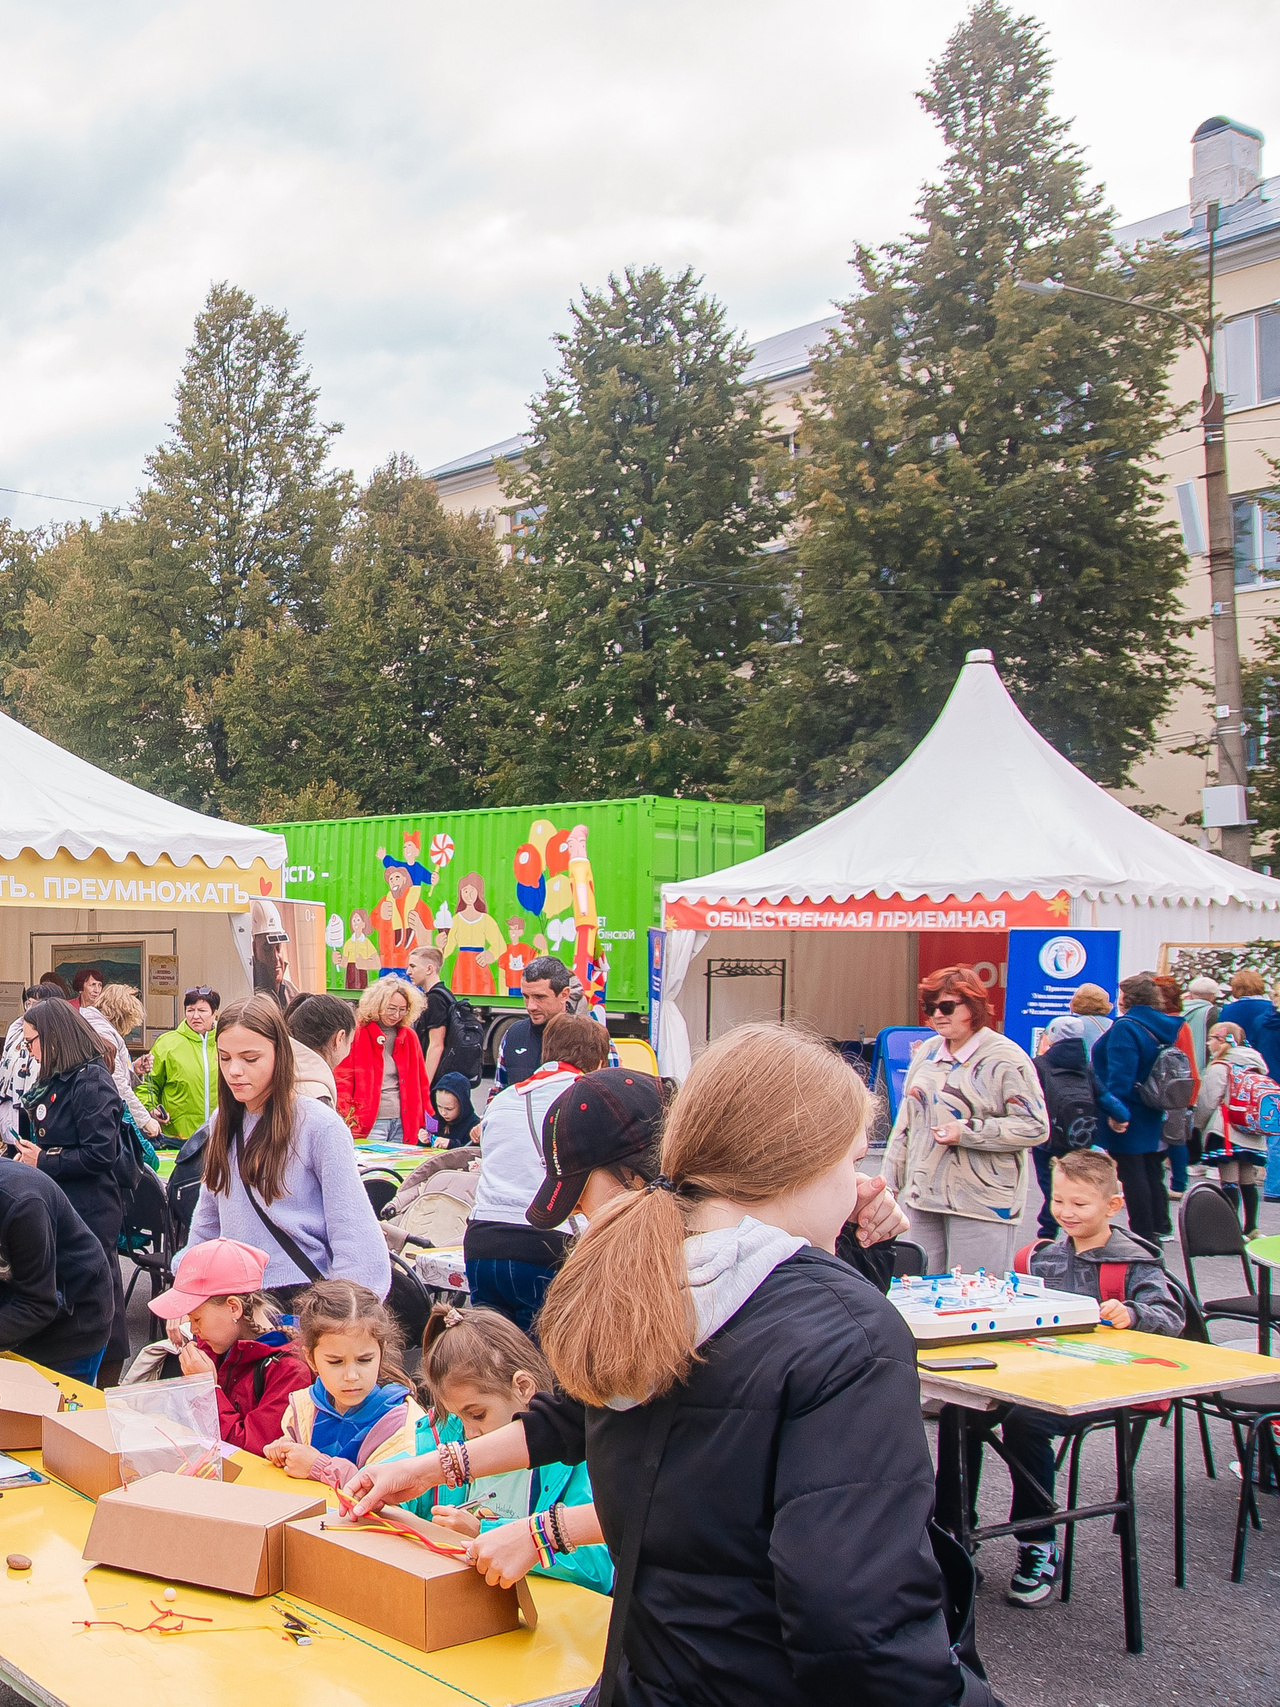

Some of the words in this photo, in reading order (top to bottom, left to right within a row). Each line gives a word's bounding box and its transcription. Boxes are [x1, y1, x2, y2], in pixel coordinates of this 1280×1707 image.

[43, 876, 251, 904] ПРЕУМНОЖАТЬ
[705, 910, 873, 930] ОБЩЕСТВЕННАЯ
[877, 909, 1006, 928] ПРИЕМНАЯ
[597, 928, 636, 940] бинской
[546, 1181, 563, 1212] famous
